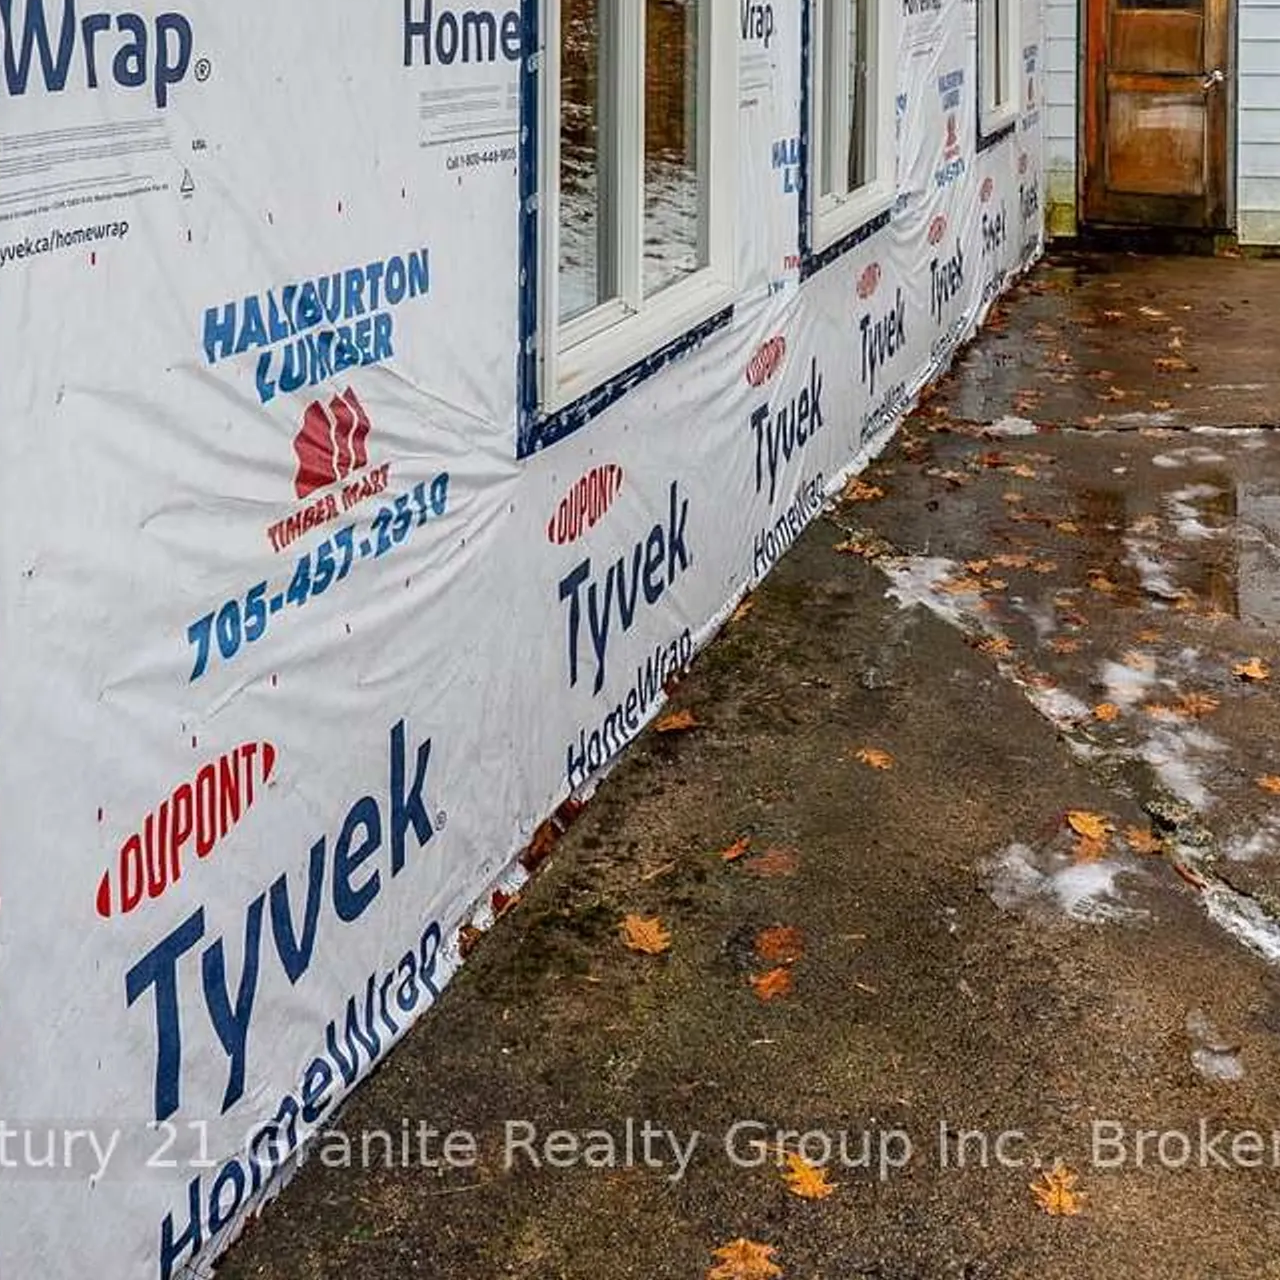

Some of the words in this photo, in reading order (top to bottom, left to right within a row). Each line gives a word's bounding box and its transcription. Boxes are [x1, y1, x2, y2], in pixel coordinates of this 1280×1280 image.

[256, 313, 394, 404] LUMBER
[859, 287, 906, 396] Tyvek
[268, 494, 339, 552] TIMBER
[342, 463, 391, 511] MART
[557, 463, 618, 545] DUPONT
[750, 356, 823, 505] Tyvek
[187, 472, 449, 683] 705-457-2510
[559, 480, 689, 697] Tyvek
[120, 743, 258, 915] DUPONT
[125, 719, 432, 1121] Tyvek
[160, 921, 440, 1280] HomeWrap
